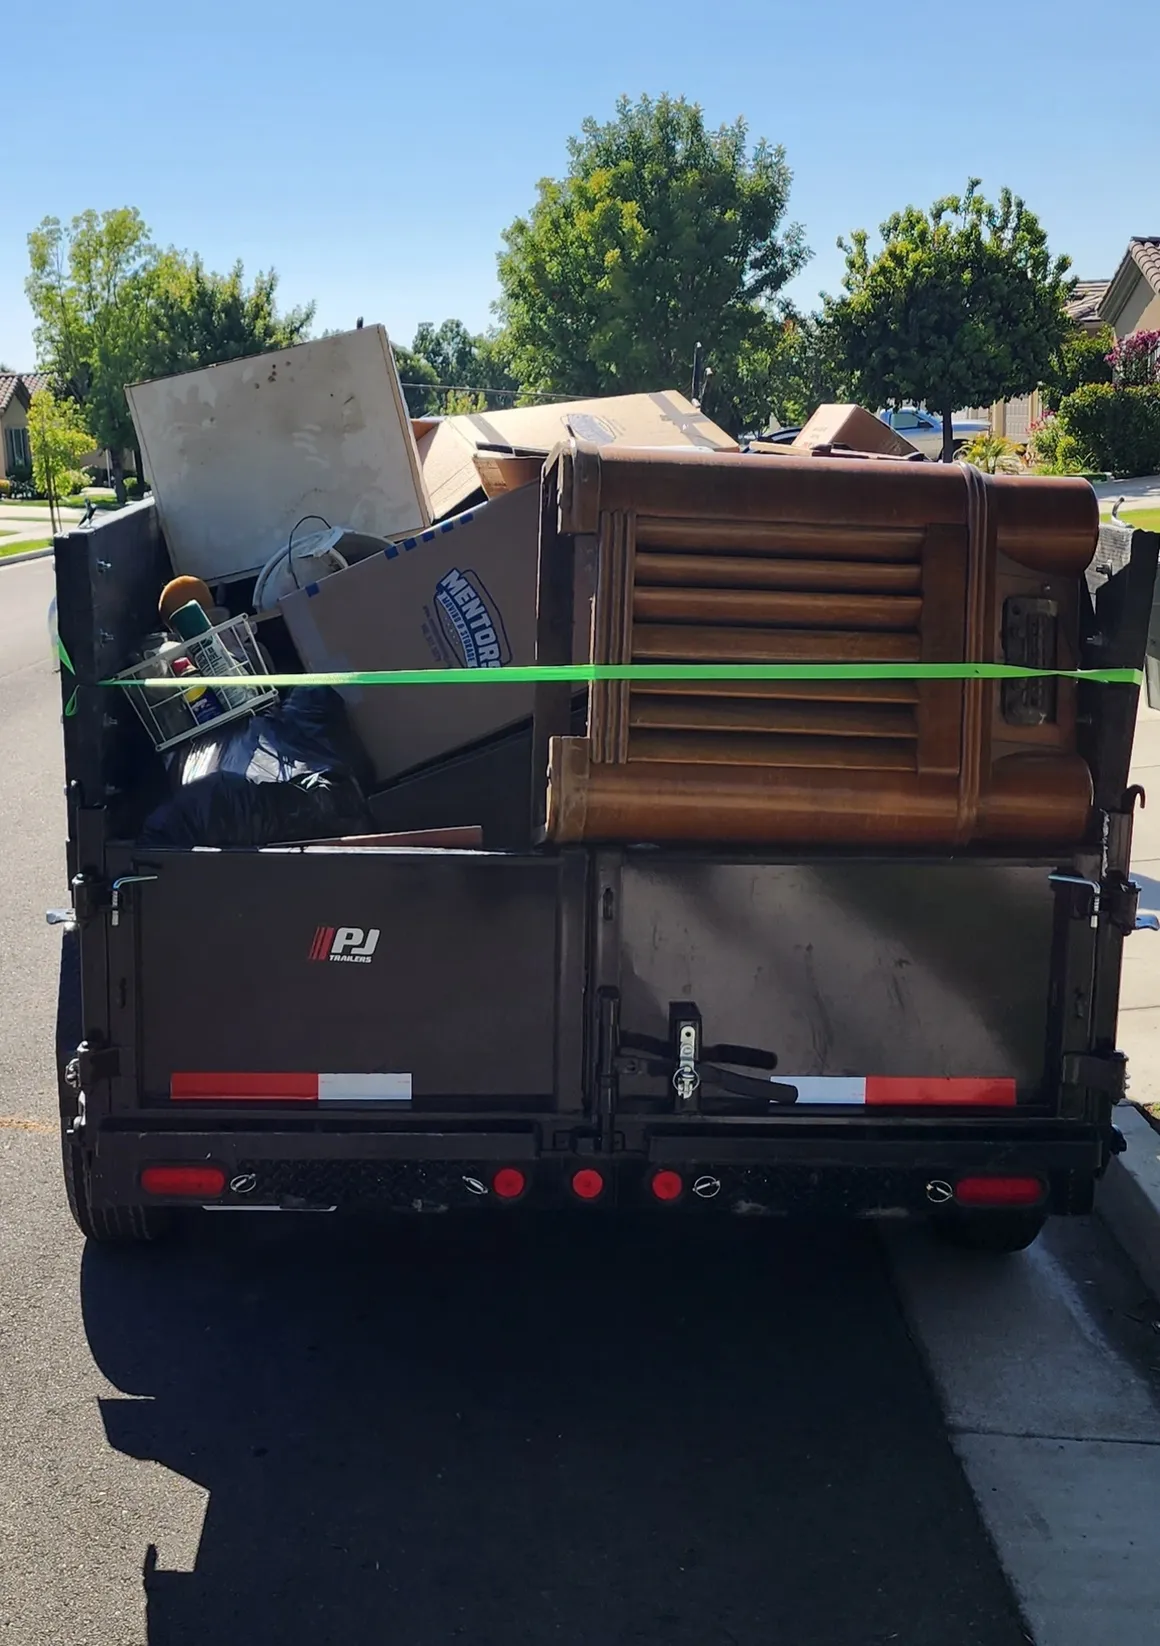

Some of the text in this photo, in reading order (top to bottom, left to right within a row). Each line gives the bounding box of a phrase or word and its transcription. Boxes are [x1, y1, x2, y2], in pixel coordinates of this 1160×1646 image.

[442, 595, 462, 623] MOVING
[460, 630, 475, 662] STORAGE
[331, 927, 380, 955] PJ
[329, 954, 372, 963] TRAILERS
